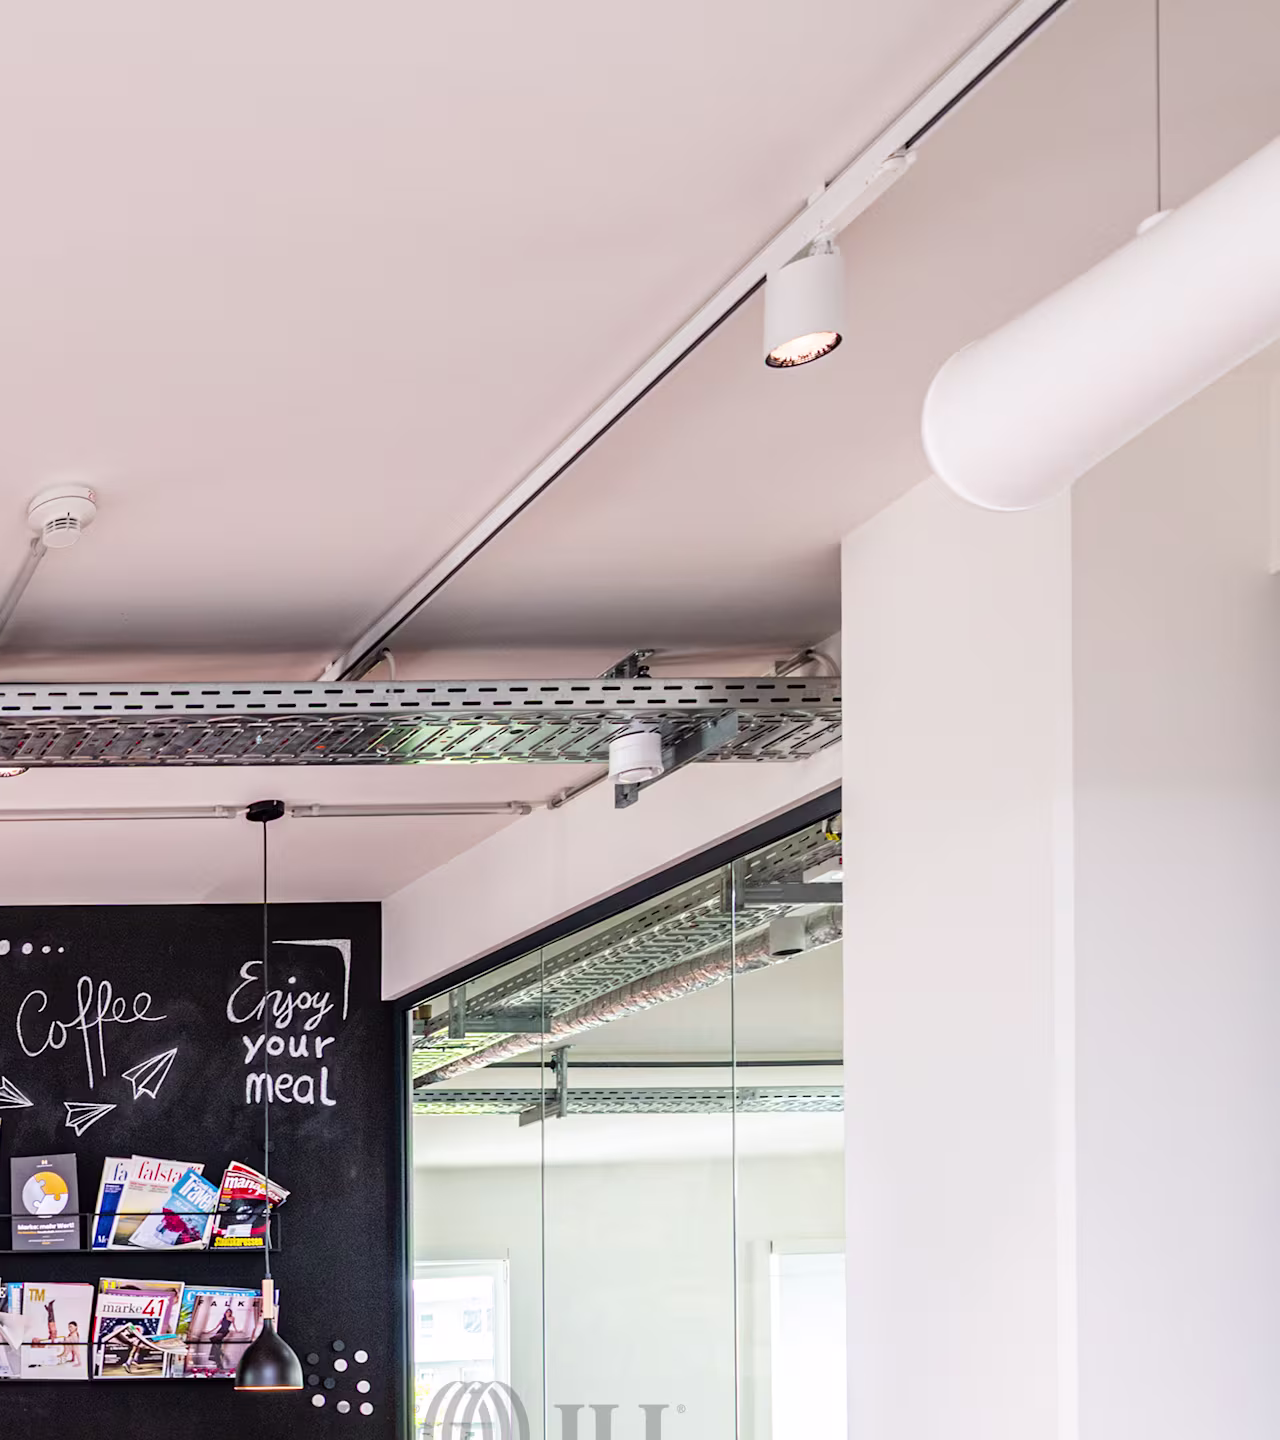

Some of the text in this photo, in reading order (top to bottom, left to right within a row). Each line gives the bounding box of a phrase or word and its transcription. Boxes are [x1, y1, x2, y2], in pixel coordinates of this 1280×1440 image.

[226, 960, 334, 1030] Enjoy
[16, 975, 167, 1089] Coffee
[241, 1034, 335, 1065] your
[246, 1066, 336, 1106] meal
[28, 1288, 45, 1302] TM
